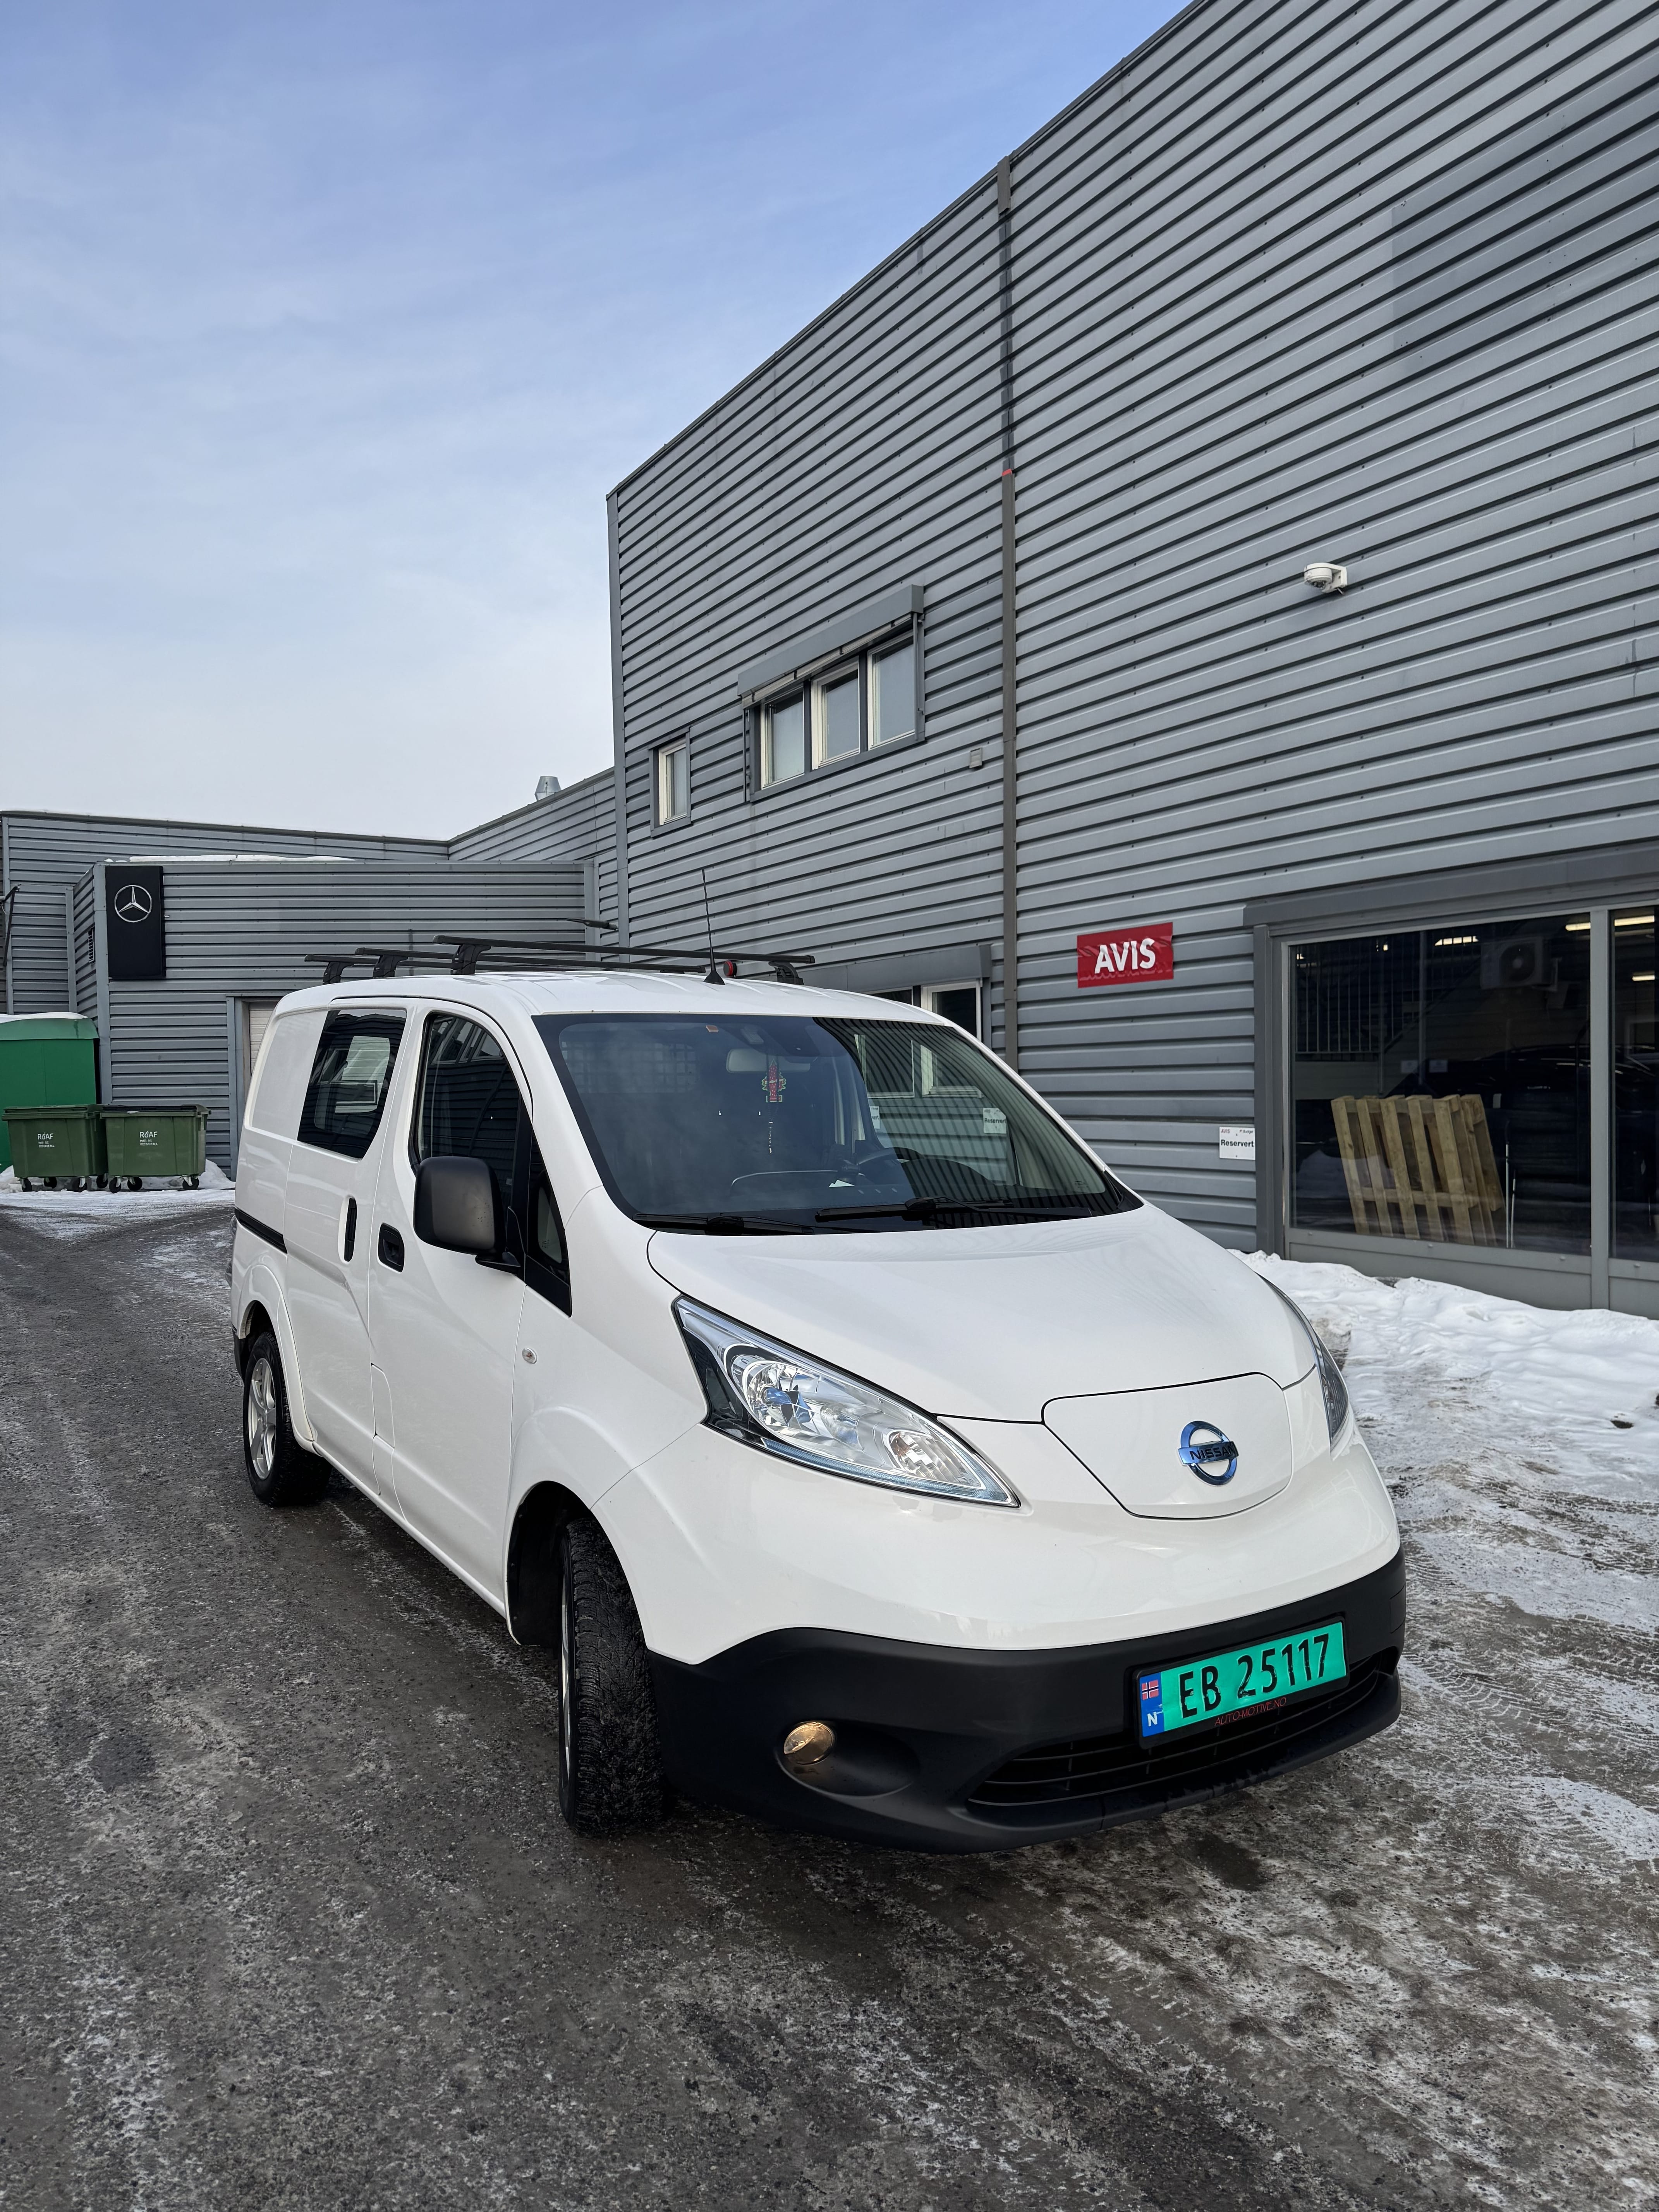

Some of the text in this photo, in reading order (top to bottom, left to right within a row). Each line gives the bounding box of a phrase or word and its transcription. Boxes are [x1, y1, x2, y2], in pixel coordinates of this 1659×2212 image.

[1094, 938, 1156, 974] AVIS
[1190, 1443, 1236, 1460] NISSAN
[1179, 1633, 1329, 1719] EB 25117
[1147, 1712, 1158, 1726] N
